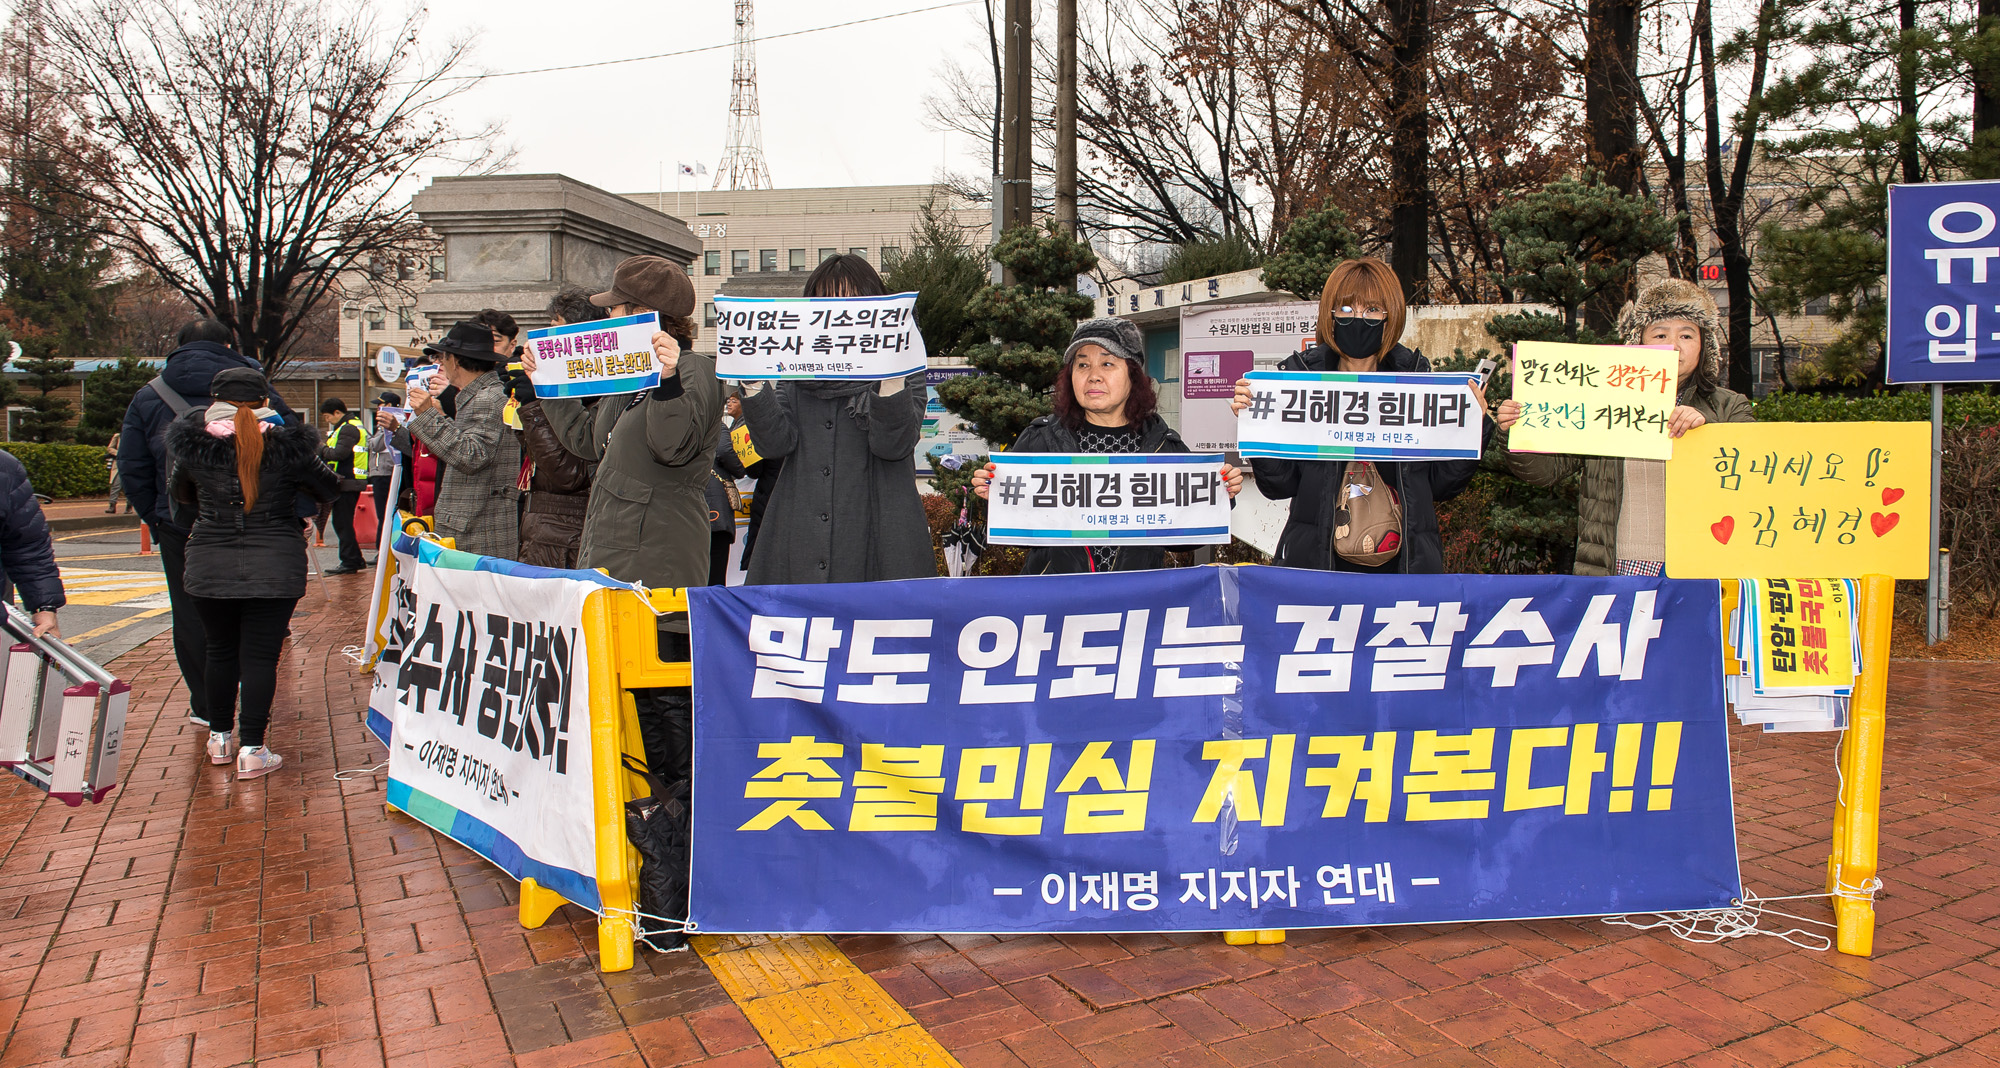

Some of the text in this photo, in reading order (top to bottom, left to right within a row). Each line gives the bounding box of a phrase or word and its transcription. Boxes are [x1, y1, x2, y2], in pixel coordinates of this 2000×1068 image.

[716, 307, 910, 331] 어이없는 기소의견!
[1208, 323, 1272, 336] 수원지방법원
[1275, 322, 1296, 334] 테마
[1924, 304, 2000, 364] 입
[537, 331, 619, 360] 공정수사 촉구한다!!
[718, 331, 910, 356] 공정수사 촉구한다!
[566, 351, 652, 379] 표적수사 분노한다!!
[788, 362, 854, 373] 이재명과 더민주
[1249, 389, 1471, 428] #김혜경 힘내라
[1594, 404, 1669, 434] 지켜본다
[1713, 446, 1846, 491] 힘내세요
[998, 471, 1221, 508] #김혜경 힘내라
[1749, 505, 1863, 548] 김혜경
[748, 589, 1664, 705] 말도 안되는 검찰수사
[419, 739, 459, 779] 이재명
[736, 720, 1684, 837] 촛불민심 지켜본다!!
[1040, 861, 1396, 913] 이재명 지지자 연대
